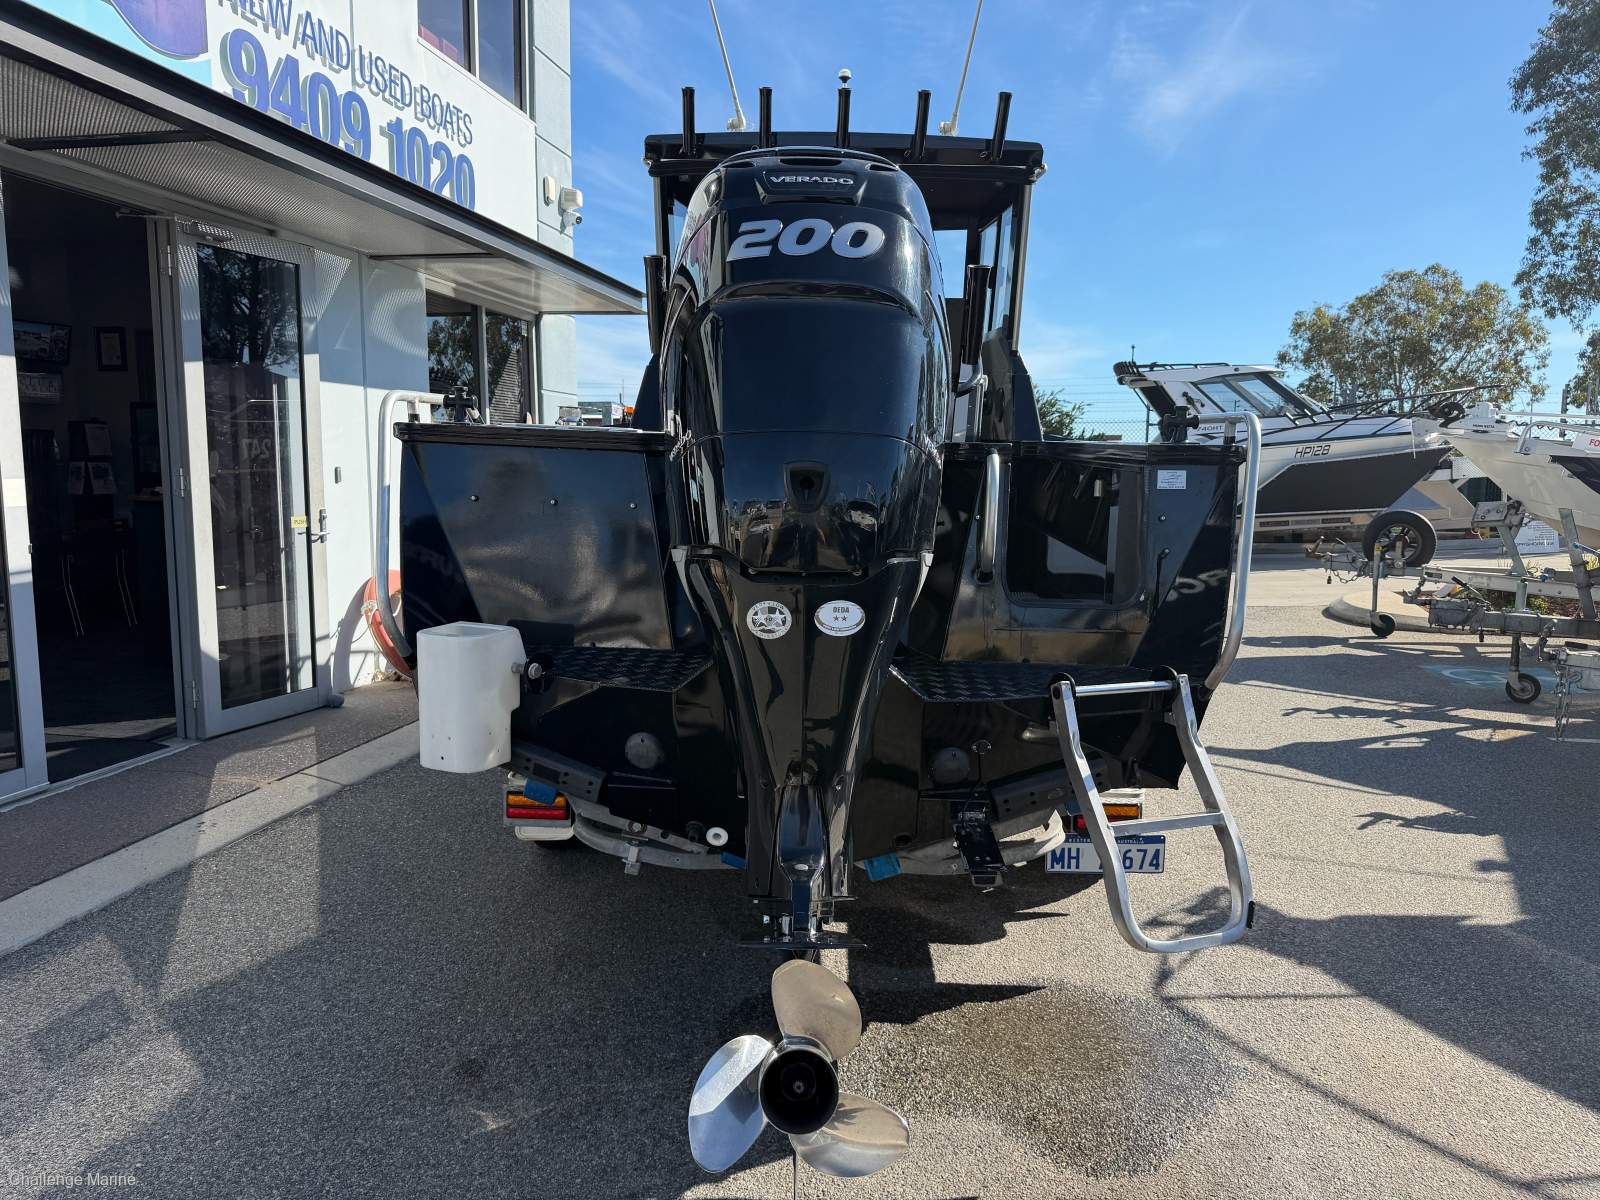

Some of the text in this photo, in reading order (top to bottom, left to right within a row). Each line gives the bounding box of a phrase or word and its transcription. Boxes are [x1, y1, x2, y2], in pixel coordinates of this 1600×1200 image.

[301, 10, 350, 70] AND
[357, 45, 412, 108] USED
[419, 84, 472, 145] BOATS
[228, 28, 475, 211] 9409 1020
[770, 175, 854, 185] VERADO
[726, 218, 886, 262] 200
[1294, 445, 1331, 458] HP128
[1589, 439, 1600, 447] FO
[1050, 847, 1161, 870] MH 674
